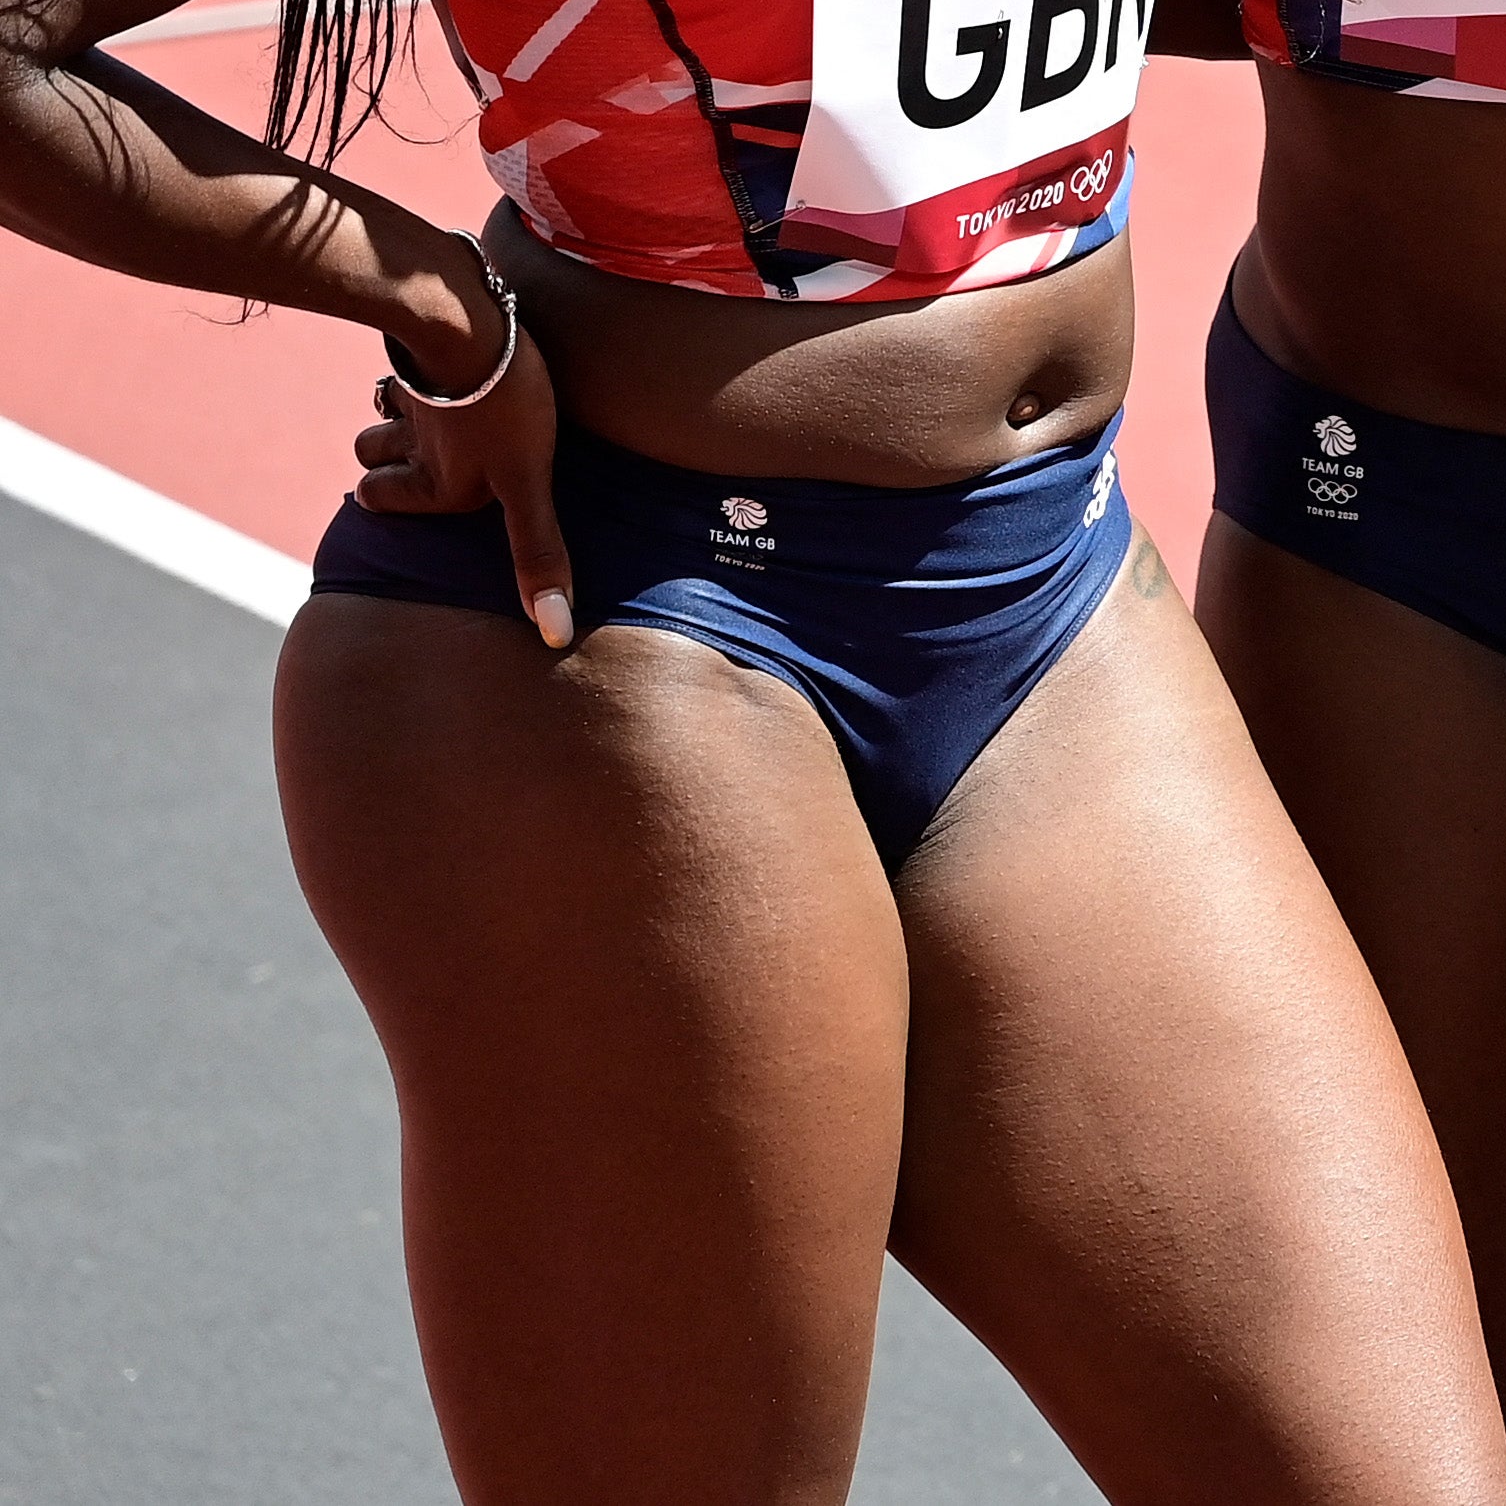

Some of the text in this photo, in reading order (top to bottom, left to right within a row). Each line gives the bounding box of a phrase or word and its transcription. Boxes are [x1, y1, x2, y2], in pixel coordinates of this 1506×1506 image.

[955, 181, 1065, 240] TOKYO 2020
[1302, 457, 1364, 479] TEAM GB
[1306, 505, 1359, 521] TOKYO 2020
[709, 528, 776, 551] TEAM GB
[714, 553, 743, 567] TOKYO
